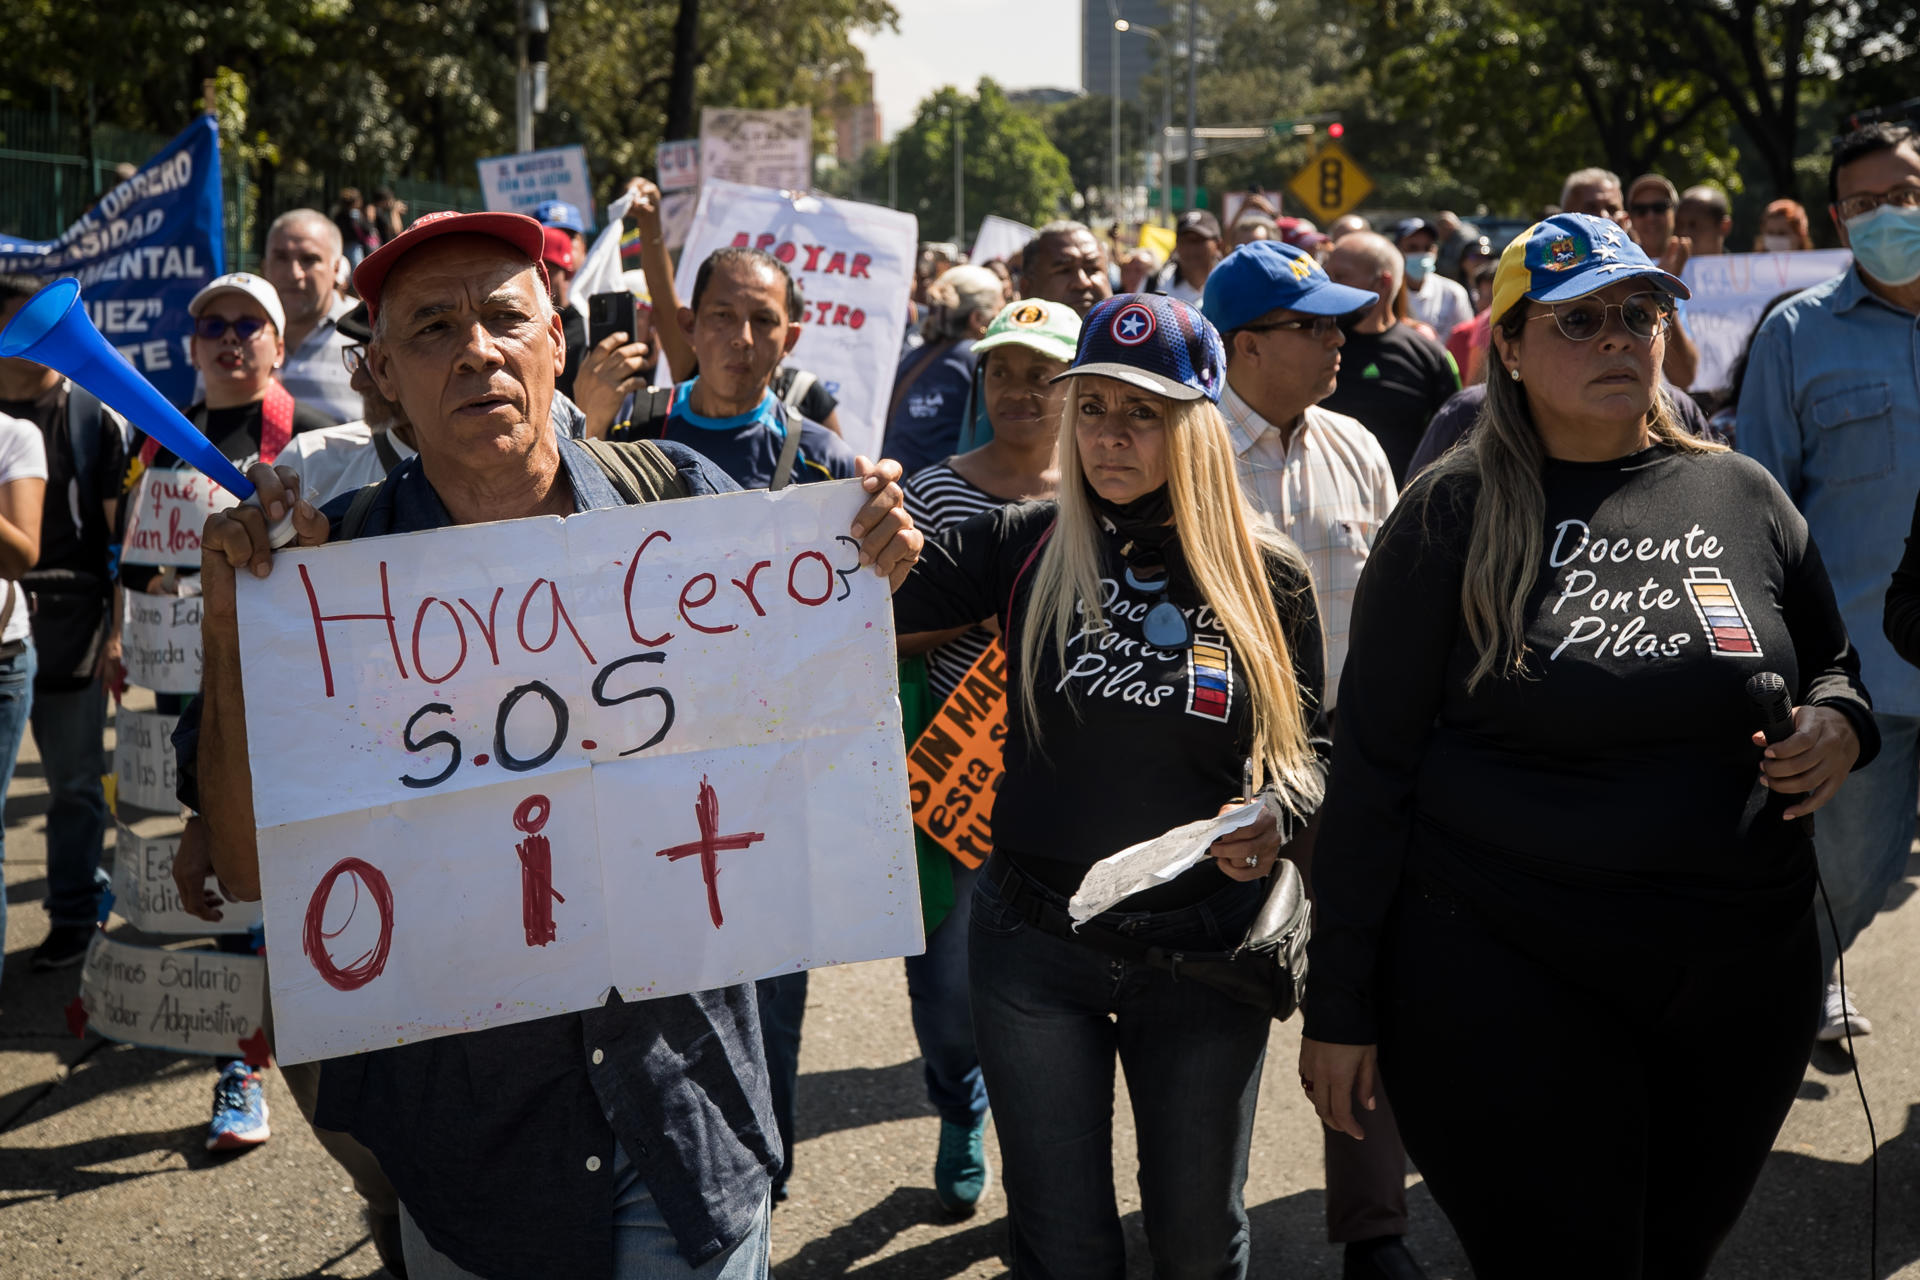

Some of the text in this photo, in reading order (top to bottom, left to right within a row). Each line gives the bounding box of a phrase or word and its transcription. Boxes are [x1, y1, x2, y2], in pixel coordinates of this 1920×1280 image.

[1549, 518, 1724, 568] Docente
[623, 530, 834, 648] Cero
[1551, 569, 1681, 615] Ponte
[1550, 615, 1691, 661] Pilas
[1054, 651, 1175, 708] Pilas
[399, 651, 676, 789] S.O.S
[928, 757, 996, 840] esta
[157, 954, 241, 995] Salario
